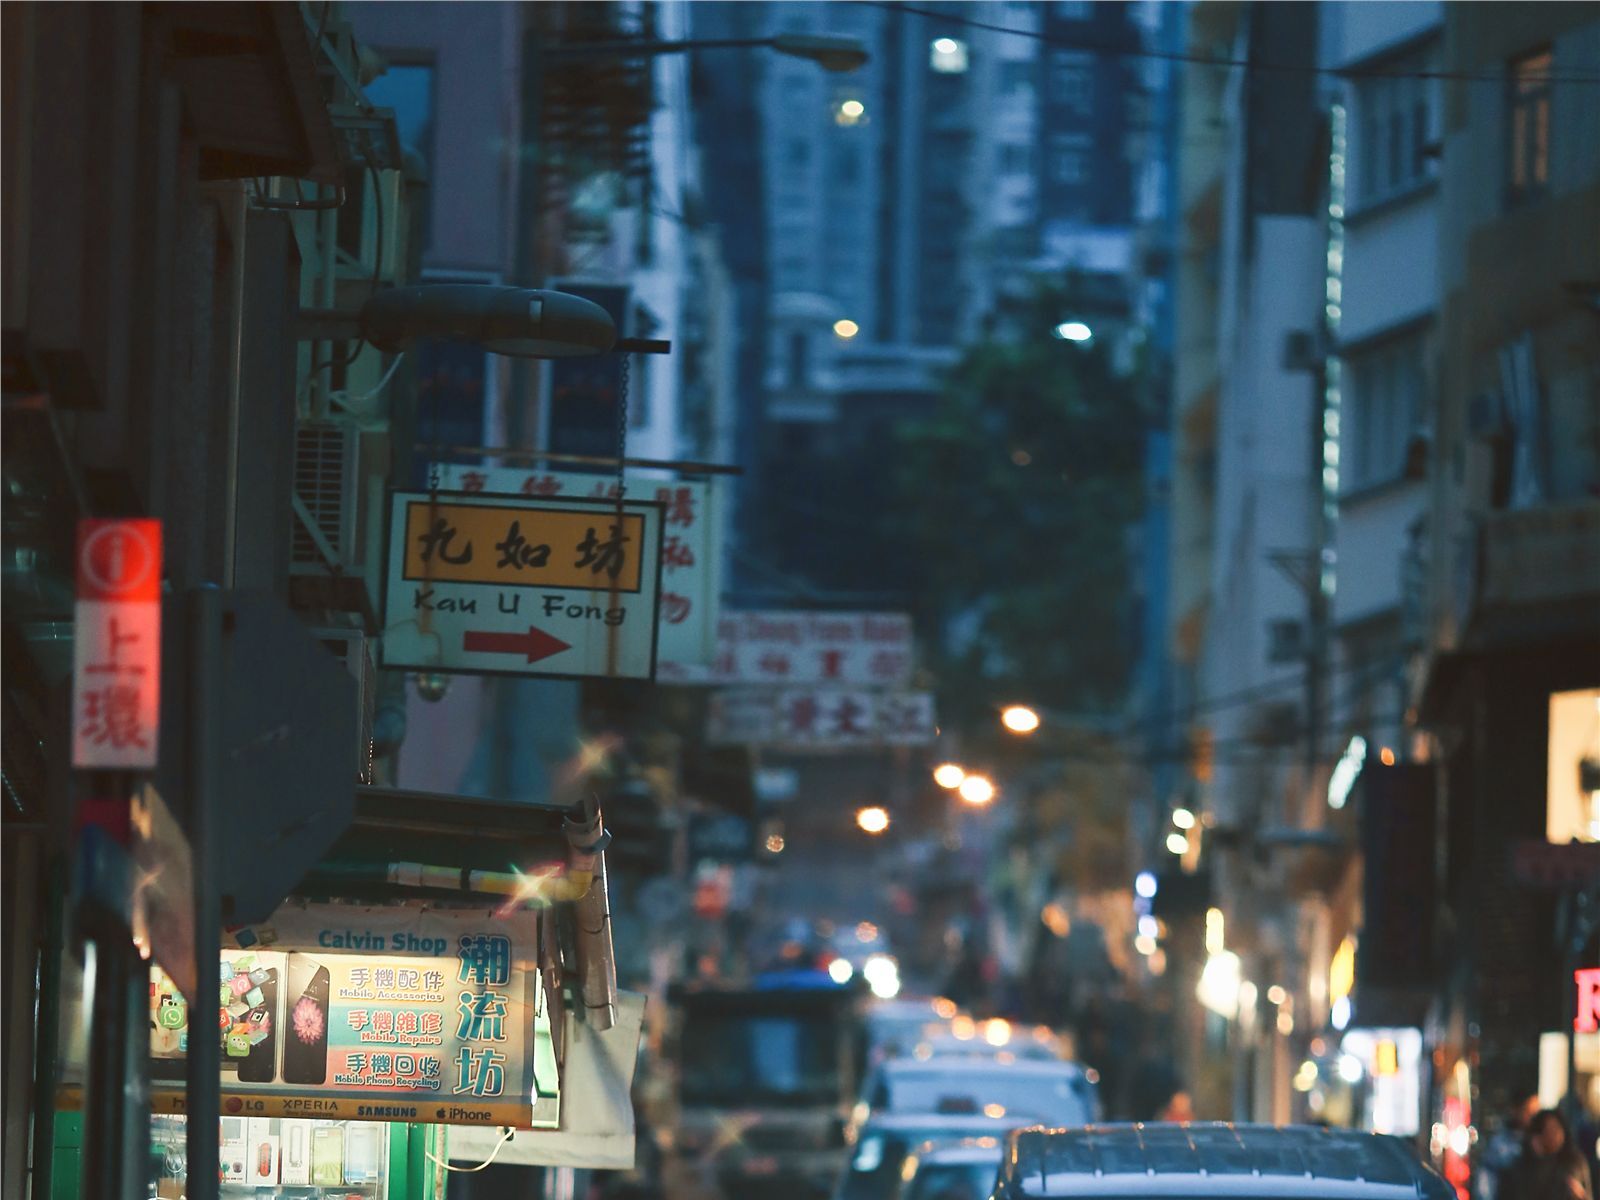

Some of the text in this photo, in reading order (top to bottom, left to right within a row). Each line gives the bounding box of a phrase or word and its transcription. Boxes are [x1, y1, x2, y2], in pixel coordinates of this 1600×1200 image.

[418, 517, 631, 579] 九如坊
[413, 588, 627, 626] Kau U Fong
[81, 615, 148, 750] 上環
[318, 929, 448, 956] Calvin Shop
[350, 967, 444, 991] 手機配件
[339, 988, 444, 1002] Mobile Accessories
[348, 1009, 442, 1034] 手機維修
[453, 933, 511, 1098] 潮流坊
[361, 1032, 442, 1045] Mobile Repairs
[346, 1052, 440, 1076] 手機回收
[334, 1074, 441, 1090] Mobile Phone Recycling
[246, 1099, 492, 1121] LG XPERIA SAMSUNG iPhone
